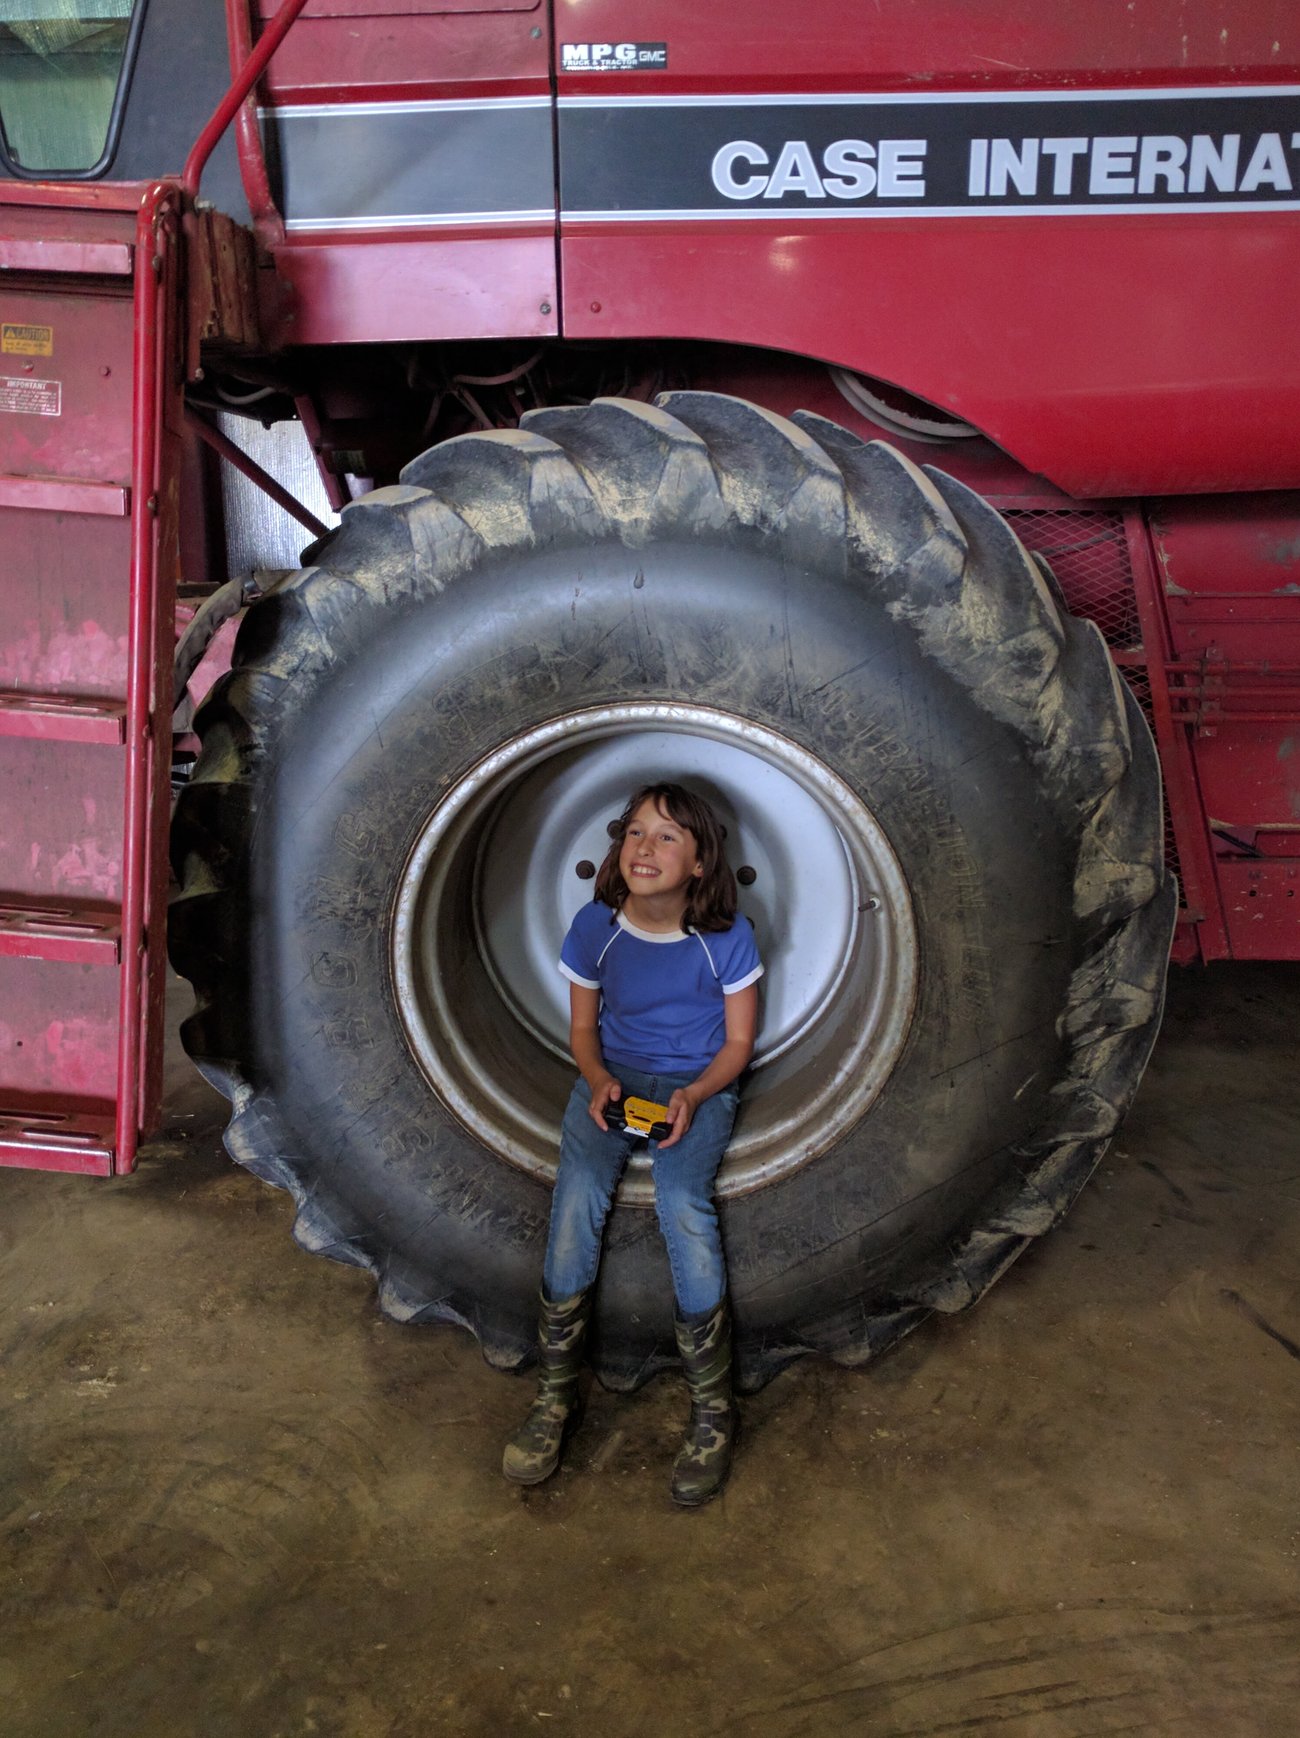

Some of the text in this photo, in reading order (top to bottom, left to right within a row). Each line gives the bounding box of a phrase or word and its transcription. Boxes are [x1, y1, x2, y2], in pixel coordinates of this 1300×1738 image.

[563, 44, 637, 60] MPG
[639, 50, 666, 61] GMC
[711, 139, 928, 200] CASE
[7, 380, 46, 390] IMPORTANT
